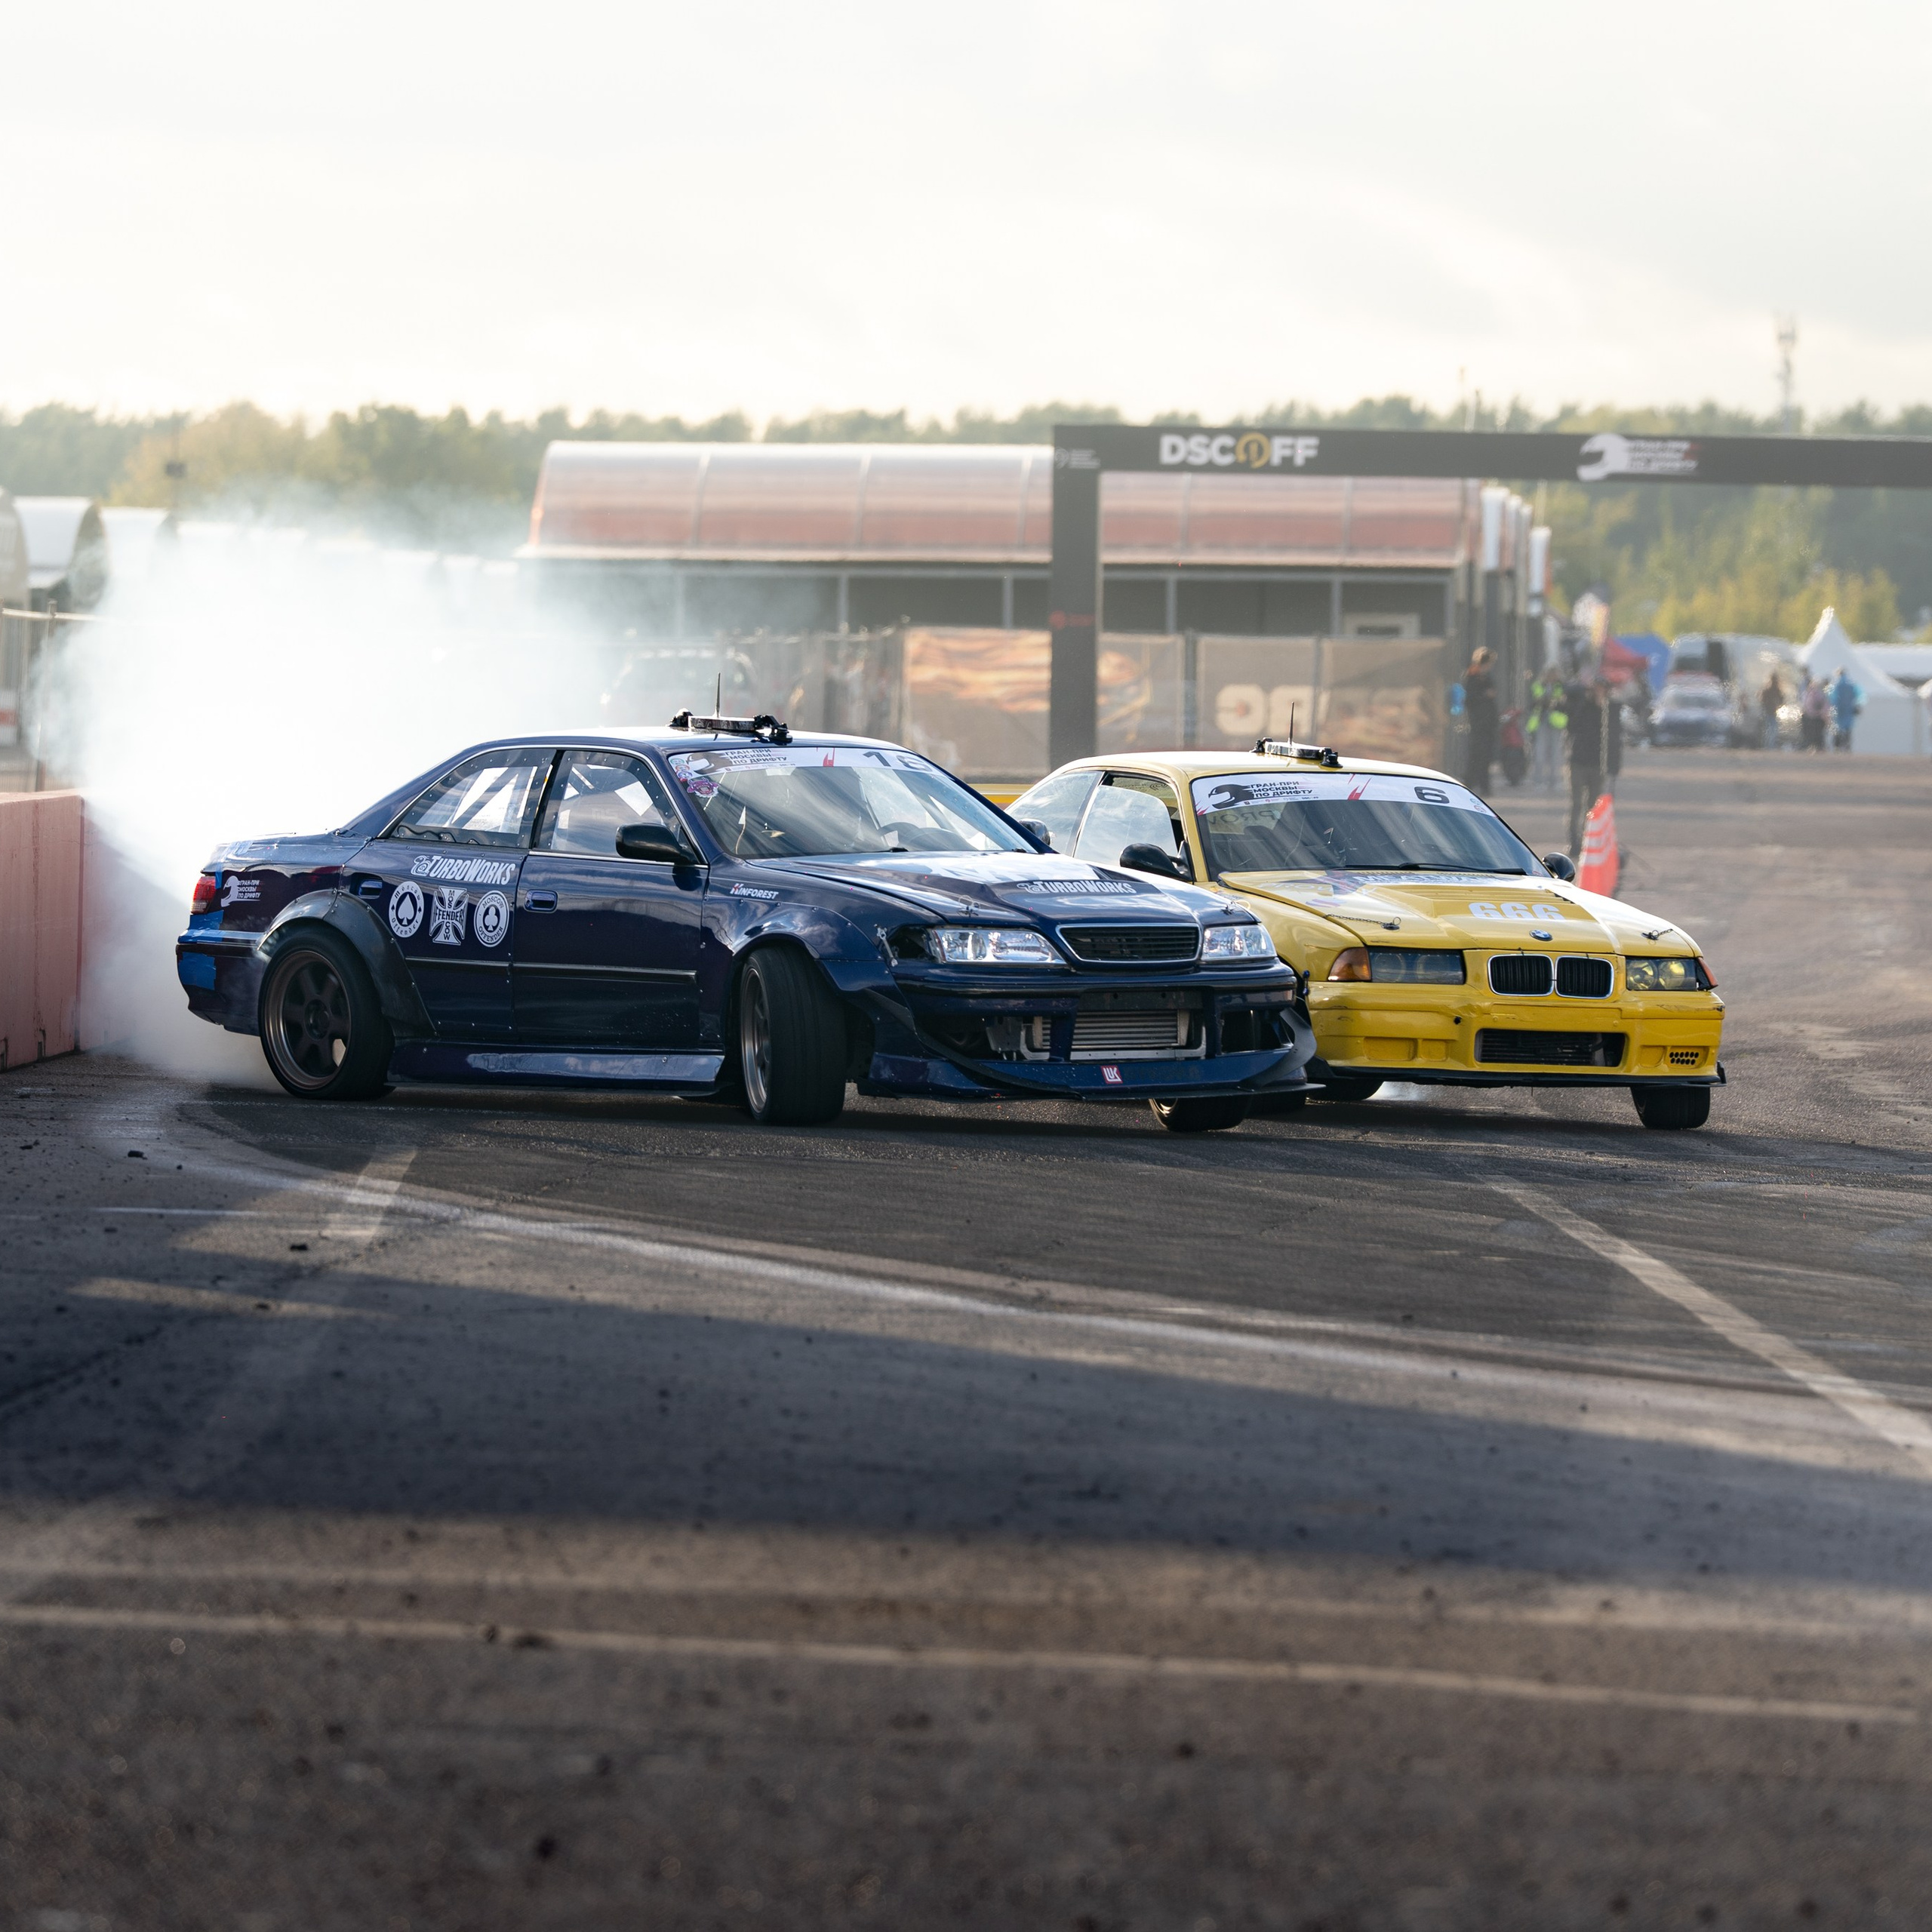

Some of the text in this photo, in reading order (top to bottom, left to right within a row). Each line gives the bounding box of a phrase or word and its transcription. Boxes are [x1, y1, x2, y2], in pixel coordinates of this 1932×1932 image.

[1272, 789, 1312, 797] ДРИФТУ
[1414, 786, 1450, 804] 6
[1468, 902, 1566, 920] 666
